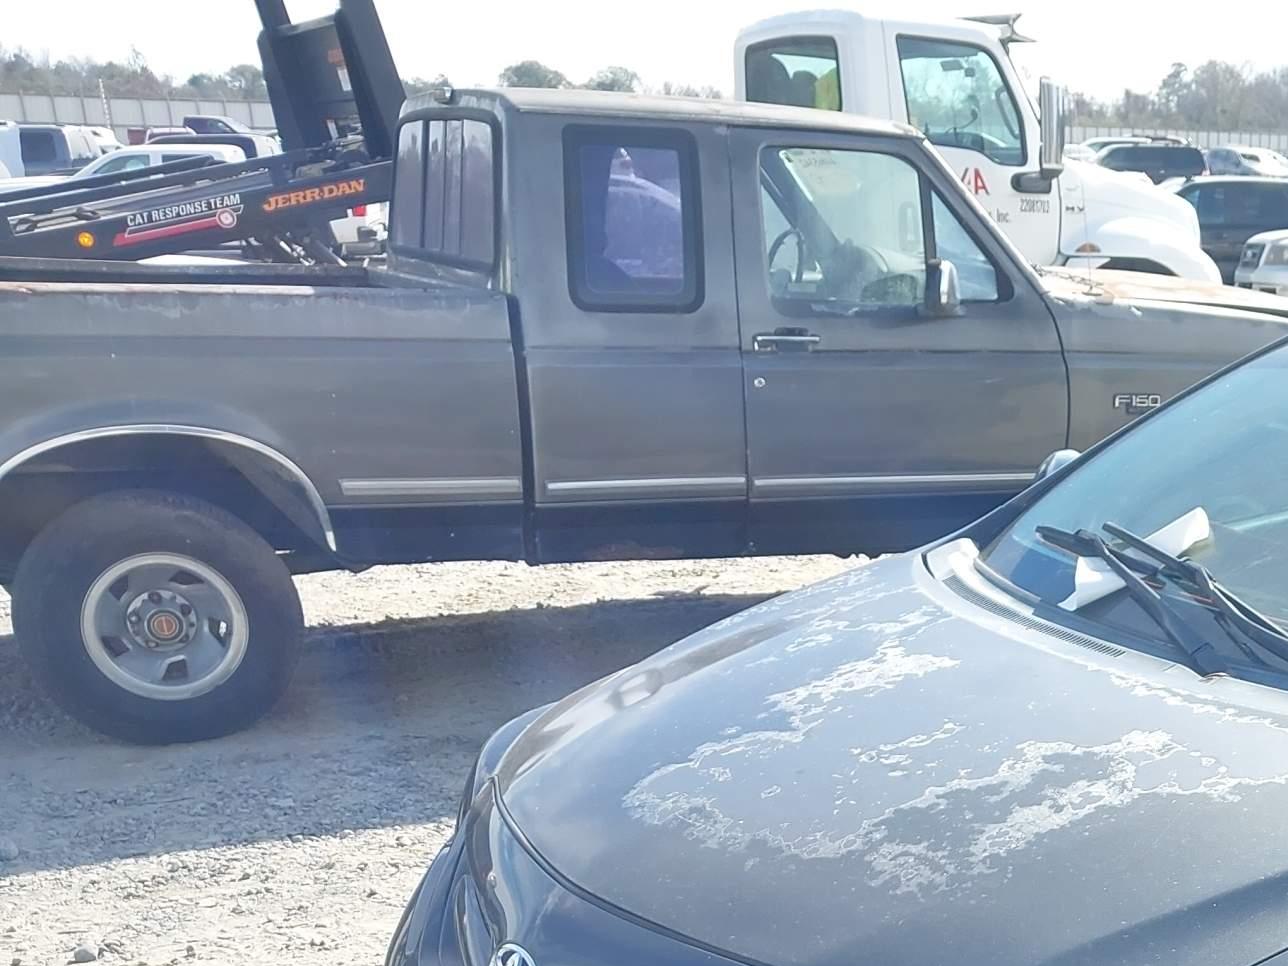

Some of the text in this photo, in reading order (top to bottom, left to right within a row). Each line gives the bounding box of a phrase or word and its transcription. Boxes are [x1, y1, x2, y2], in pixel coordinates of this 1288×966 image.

[127, 193, 241, 226] CAT RESPONSE TEAM
[1114, 394, 1161, 408] F150
